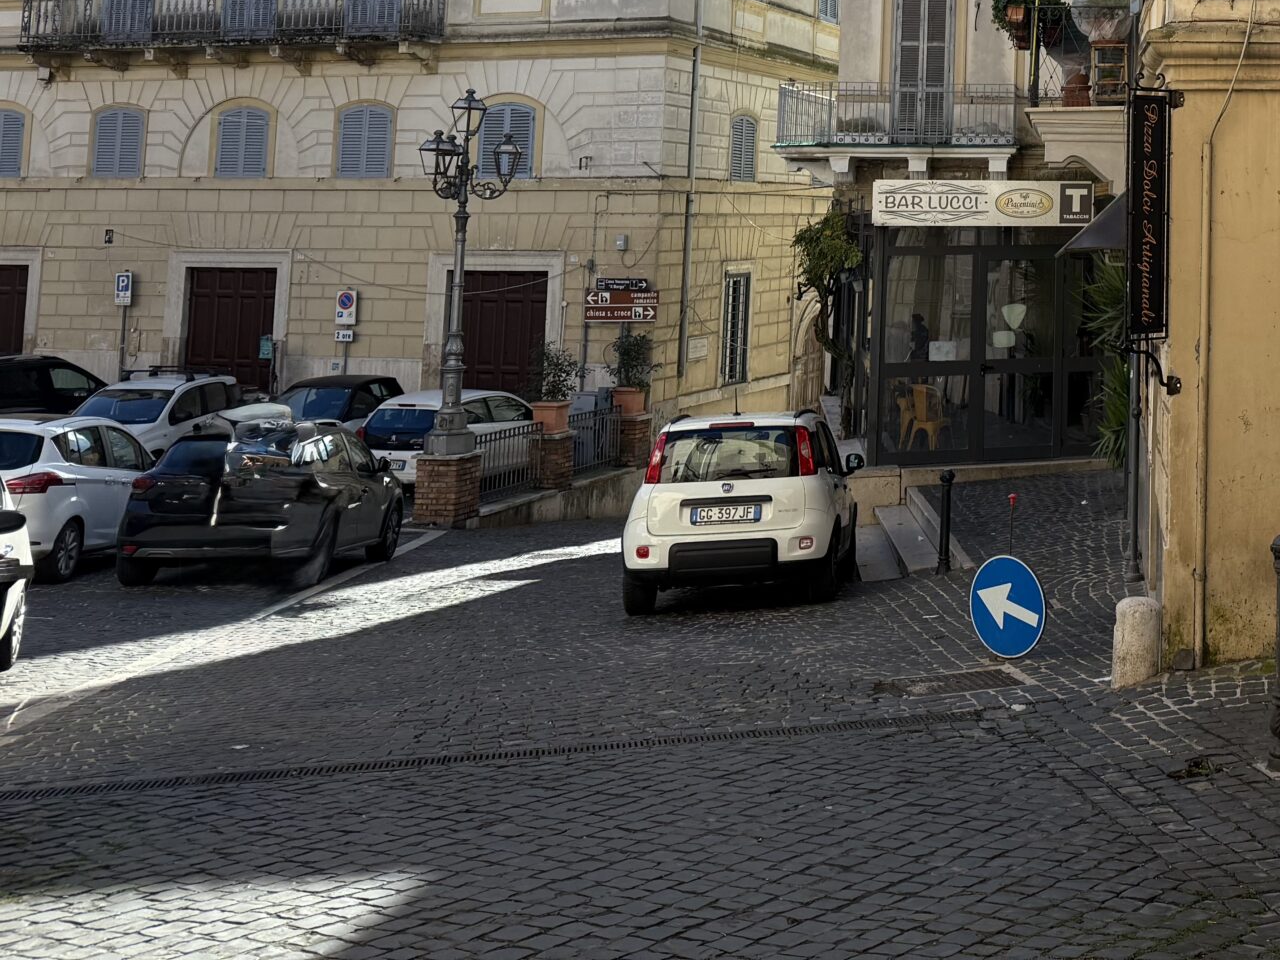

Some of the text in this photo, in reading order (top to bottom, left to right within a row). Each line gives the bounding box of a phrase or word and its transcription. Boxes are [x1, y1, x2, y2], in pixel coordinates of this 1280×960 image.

[884, 194, 980, 210] BAR LUCCI
[1065, 188, 1088, 213] T
[1136, 102, 1159, 326] Pizza Dolci Artigianali
[586, 309, 606, 317] chiesa
[336, 331, 340, 339] 2
